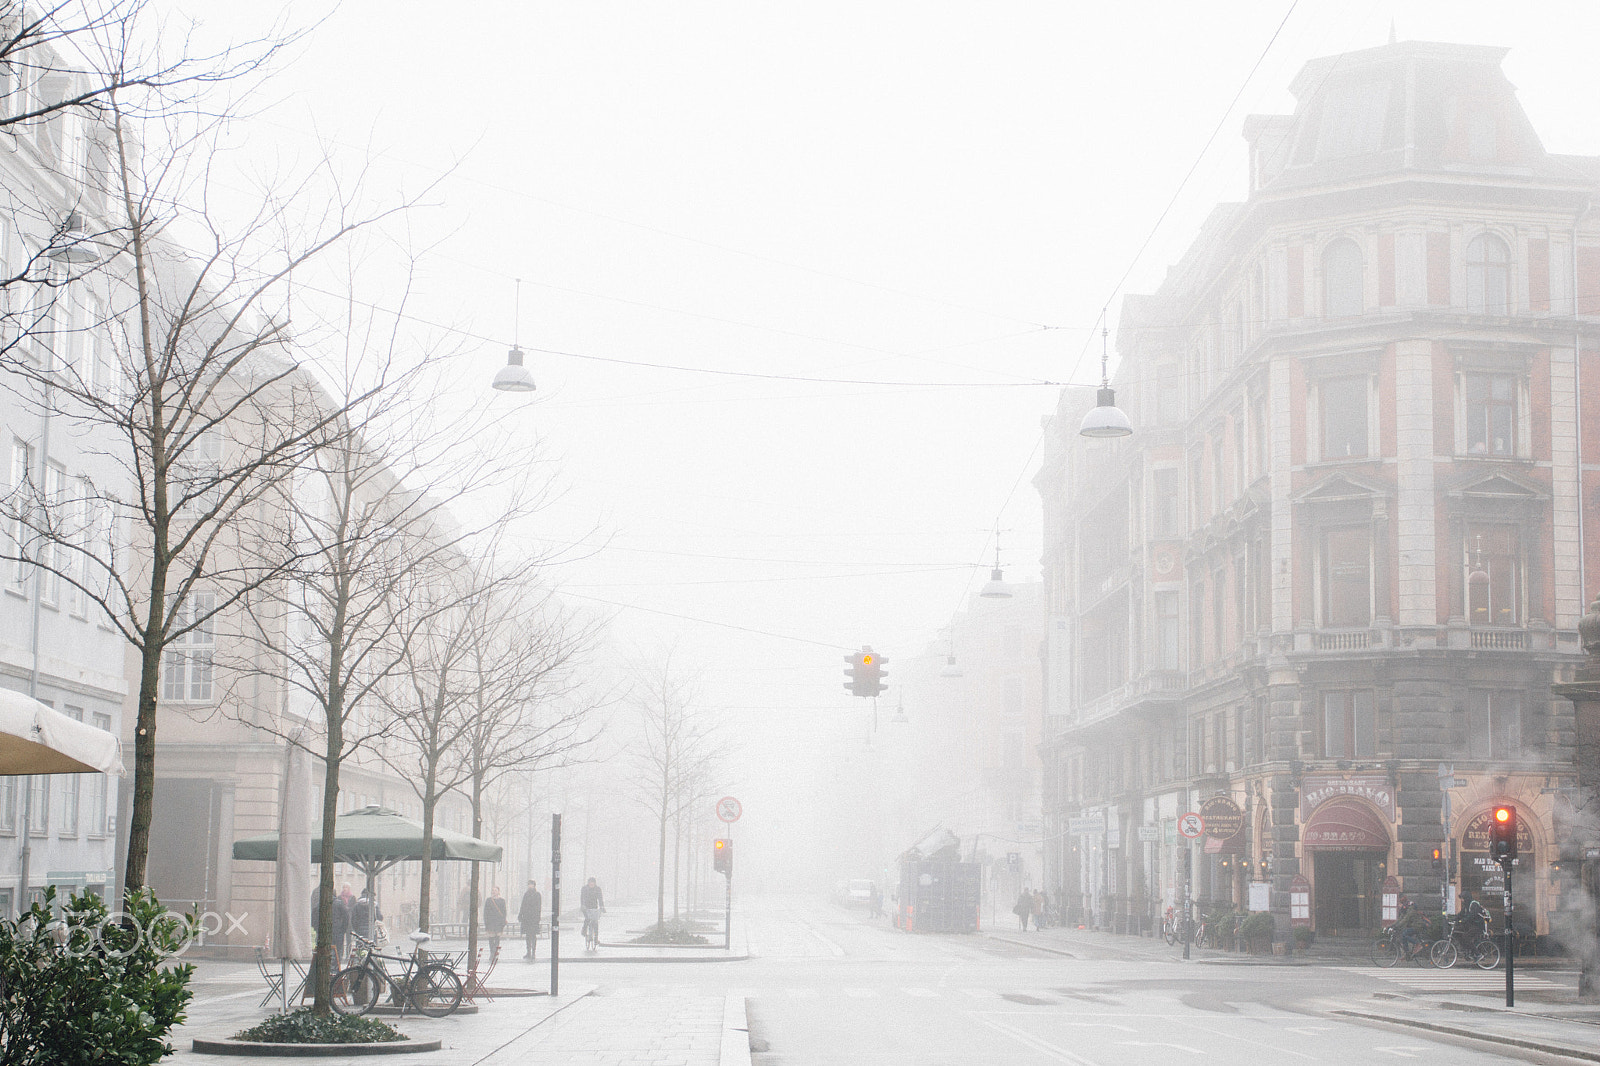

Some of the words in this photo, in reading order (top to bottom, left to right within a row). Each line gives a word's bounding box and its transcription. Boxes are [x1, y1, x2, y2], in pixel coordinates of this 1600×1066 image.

[1306, 786, 1334, 808] RIO
[1339, 786, 1390, 807] BRAVO
[1471, 815, 1487, 830] RIO
